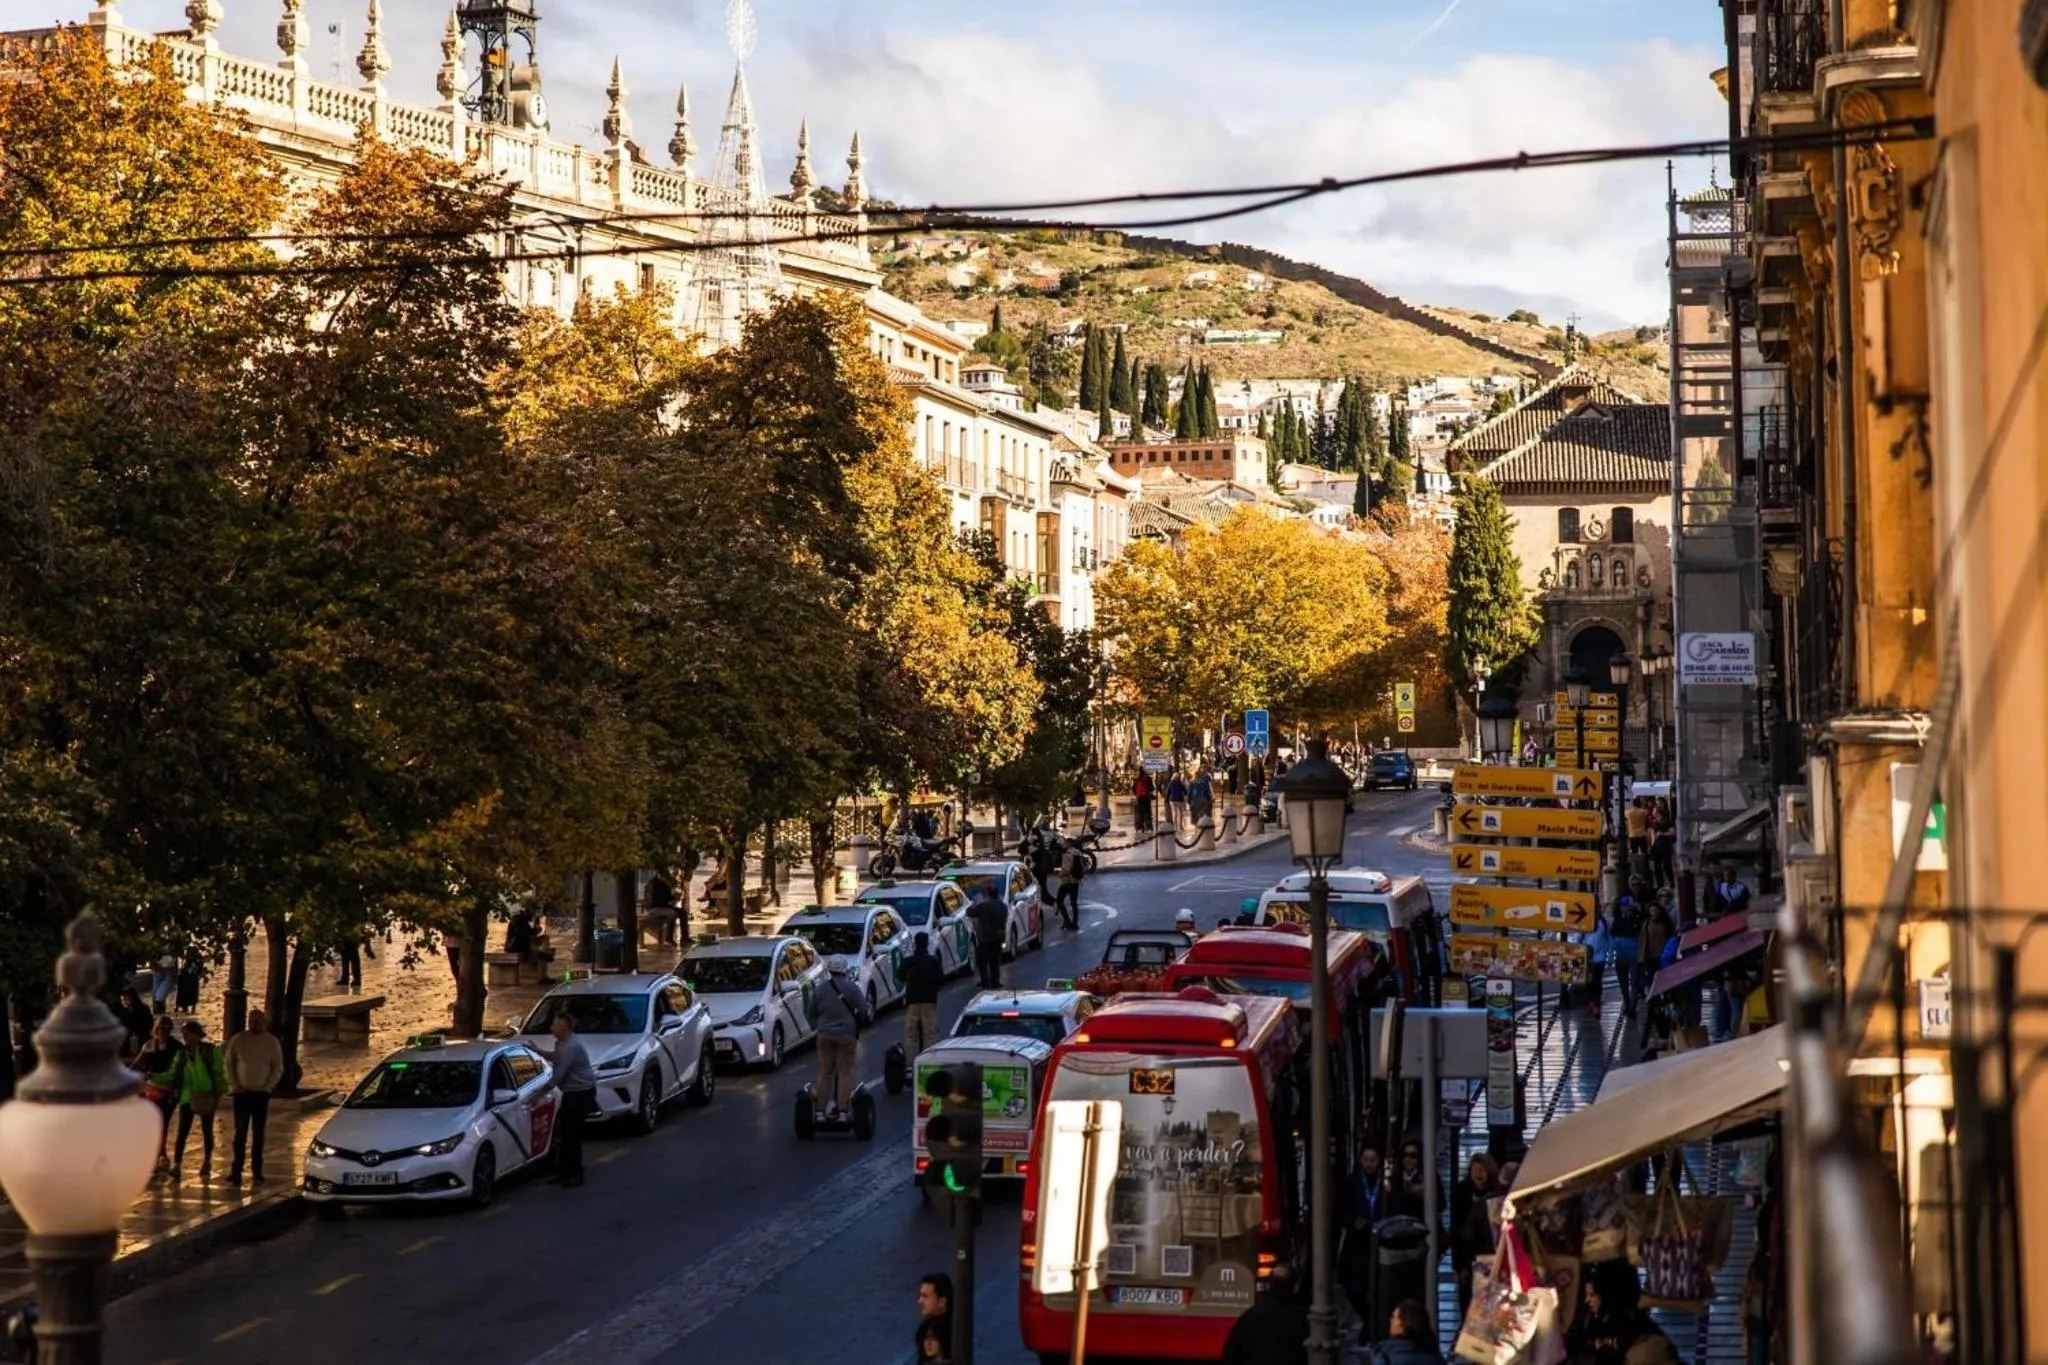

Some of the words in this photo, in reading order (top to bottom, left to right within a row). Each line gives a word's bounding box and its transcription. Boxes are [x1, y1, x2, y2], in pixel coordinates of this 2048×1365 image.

[1568, 825, 1596, 836] Plaza
[1556, 865, 1594, 876] Antares
[1456, 910, 1481, 921] Viena
[1133, 1070, 1173, 1092] C32
[1125, 1144, 1156, 1161] vas
[1160, 1144, 1172, 1161] a
[1176, 1139, 1245, 1171] perder?
